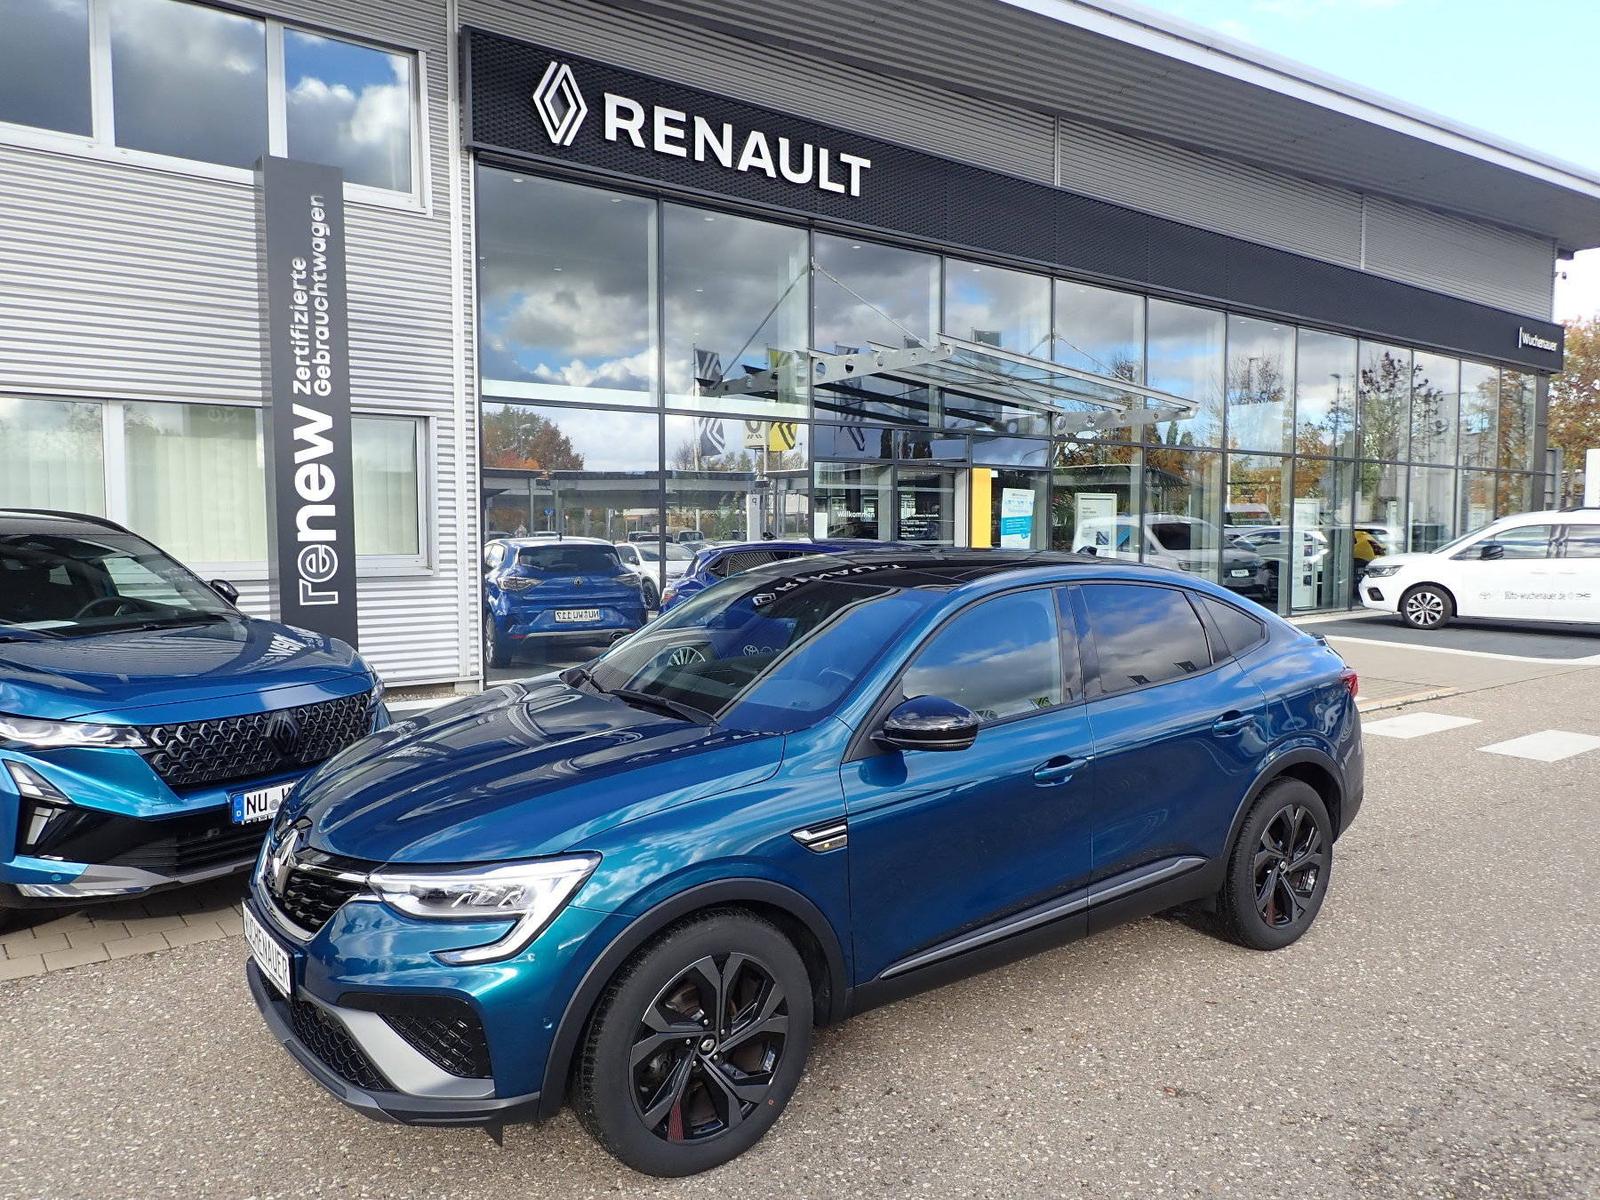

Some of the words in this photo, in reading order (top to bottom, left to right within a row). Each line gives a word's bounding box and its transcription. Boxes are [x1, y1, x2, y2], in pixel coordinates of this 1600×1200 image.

[604, 92, 871, 197] RENAULT
[289, 255, 312, 395] Zertifizierte
[310, 193, 332, 397] Gebrauchtwagen
[292, 404, 339, 607] renew
[837, 510, 875, 518] Willkommen
[246, 792, 268, 815] NU
